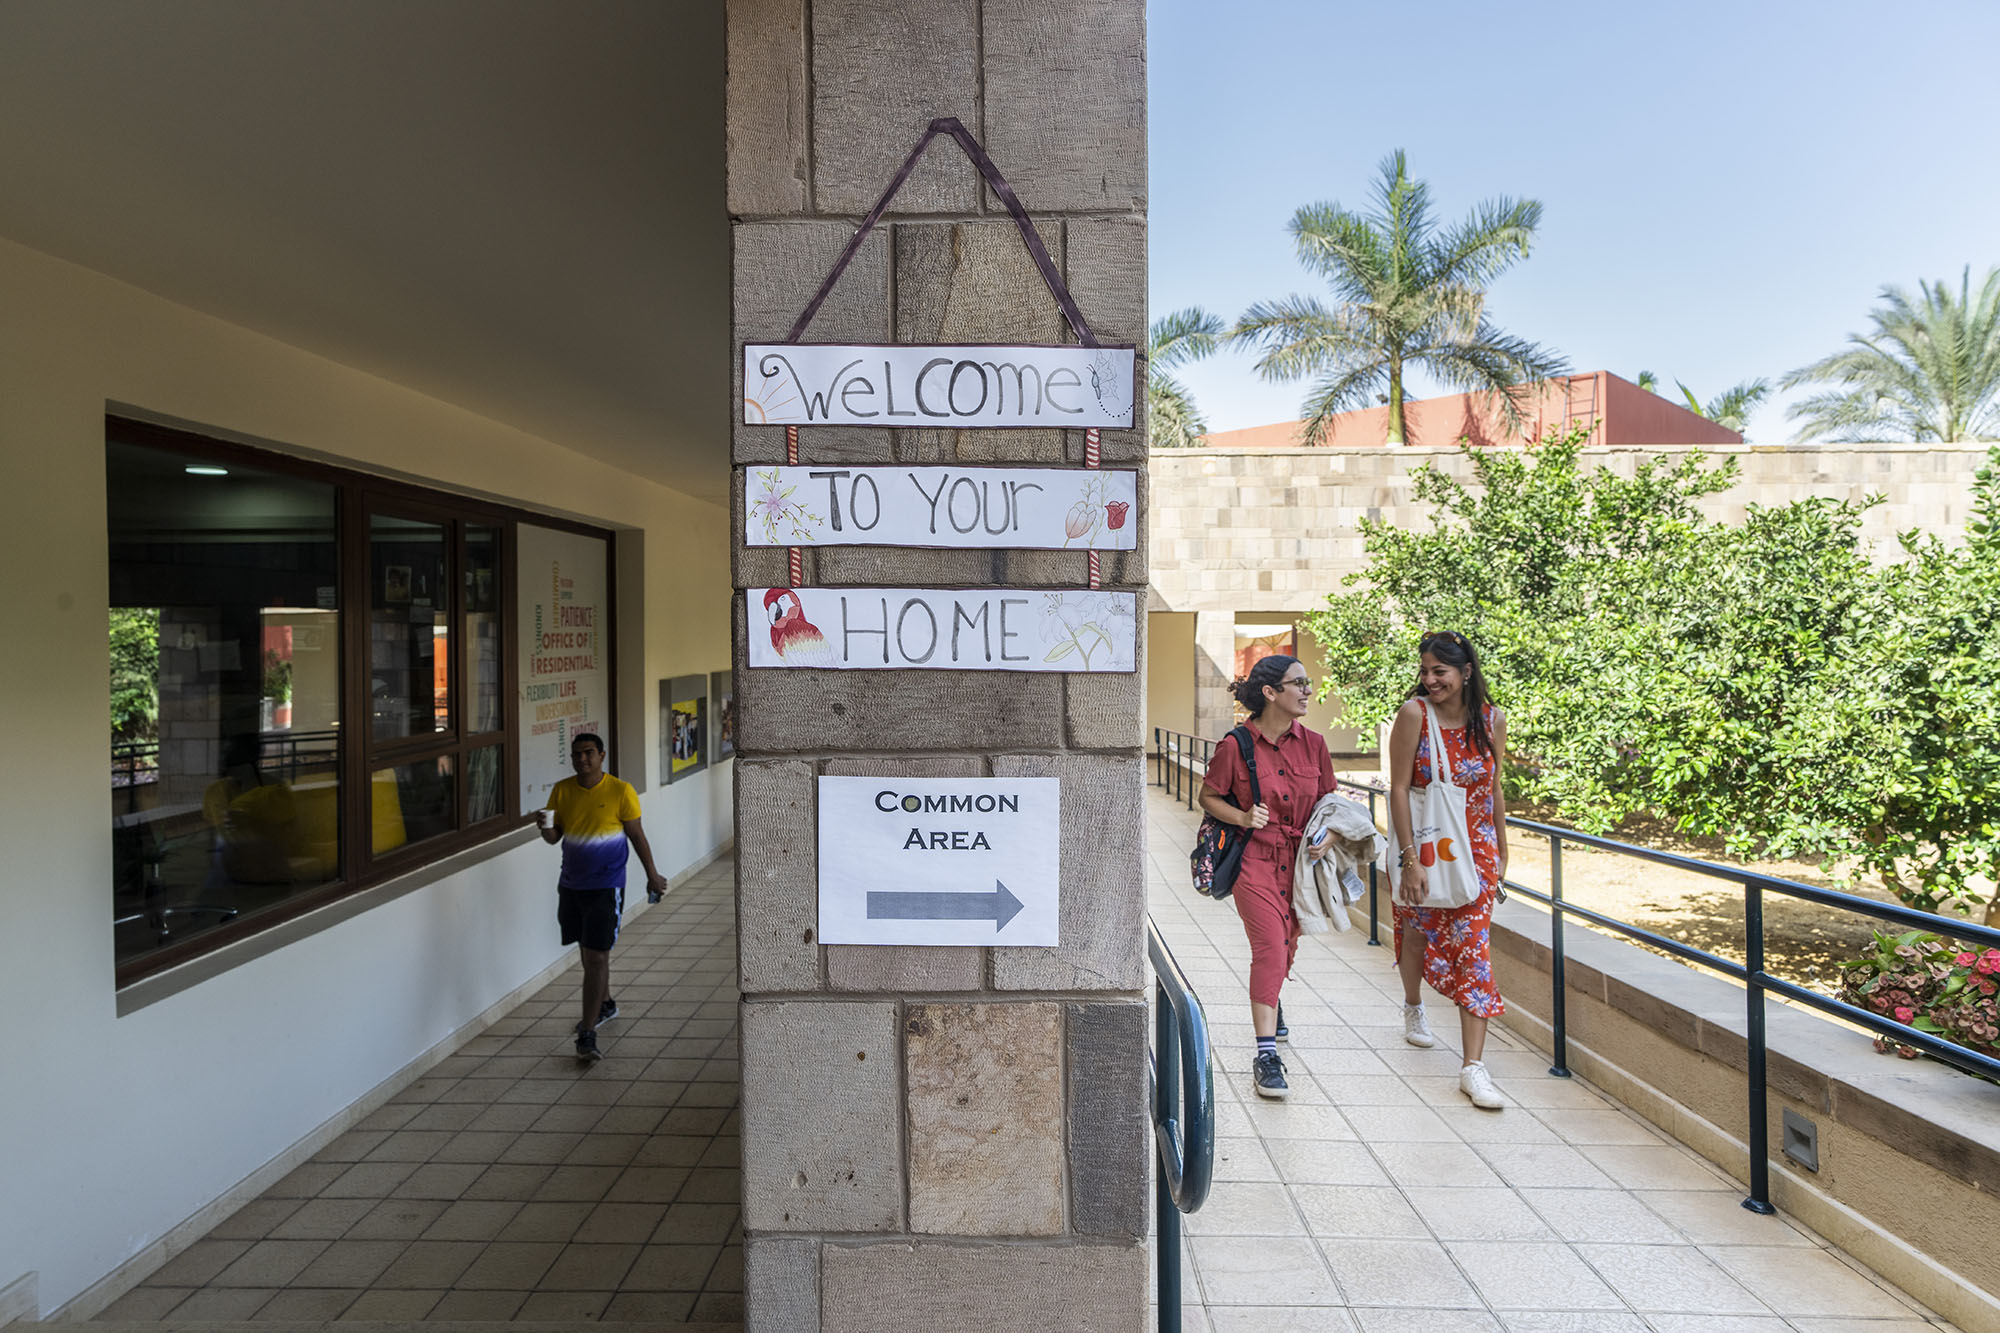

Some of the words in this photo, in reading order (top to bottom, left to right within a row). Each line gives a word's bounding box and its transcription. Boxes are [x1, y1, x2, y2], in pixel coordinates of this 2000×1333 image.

[809, 470, 881, 532] TO
[552, 560, 560, 629] COMMITMENT
[560, 605, 592, 628] PATIENCE
[542, 632, 574, 650] OFFICE
[576, 632, 588, 648] OF
[841, 597, 1030, 664] HOME
[536, 655, 593, 674] RESIDENTIAL
[526, 683, 560, 702] FLEXIBILITY
[560, 680, 577, 698] LIFE
[536, 698, 583, 722] UNDERSTANDING
